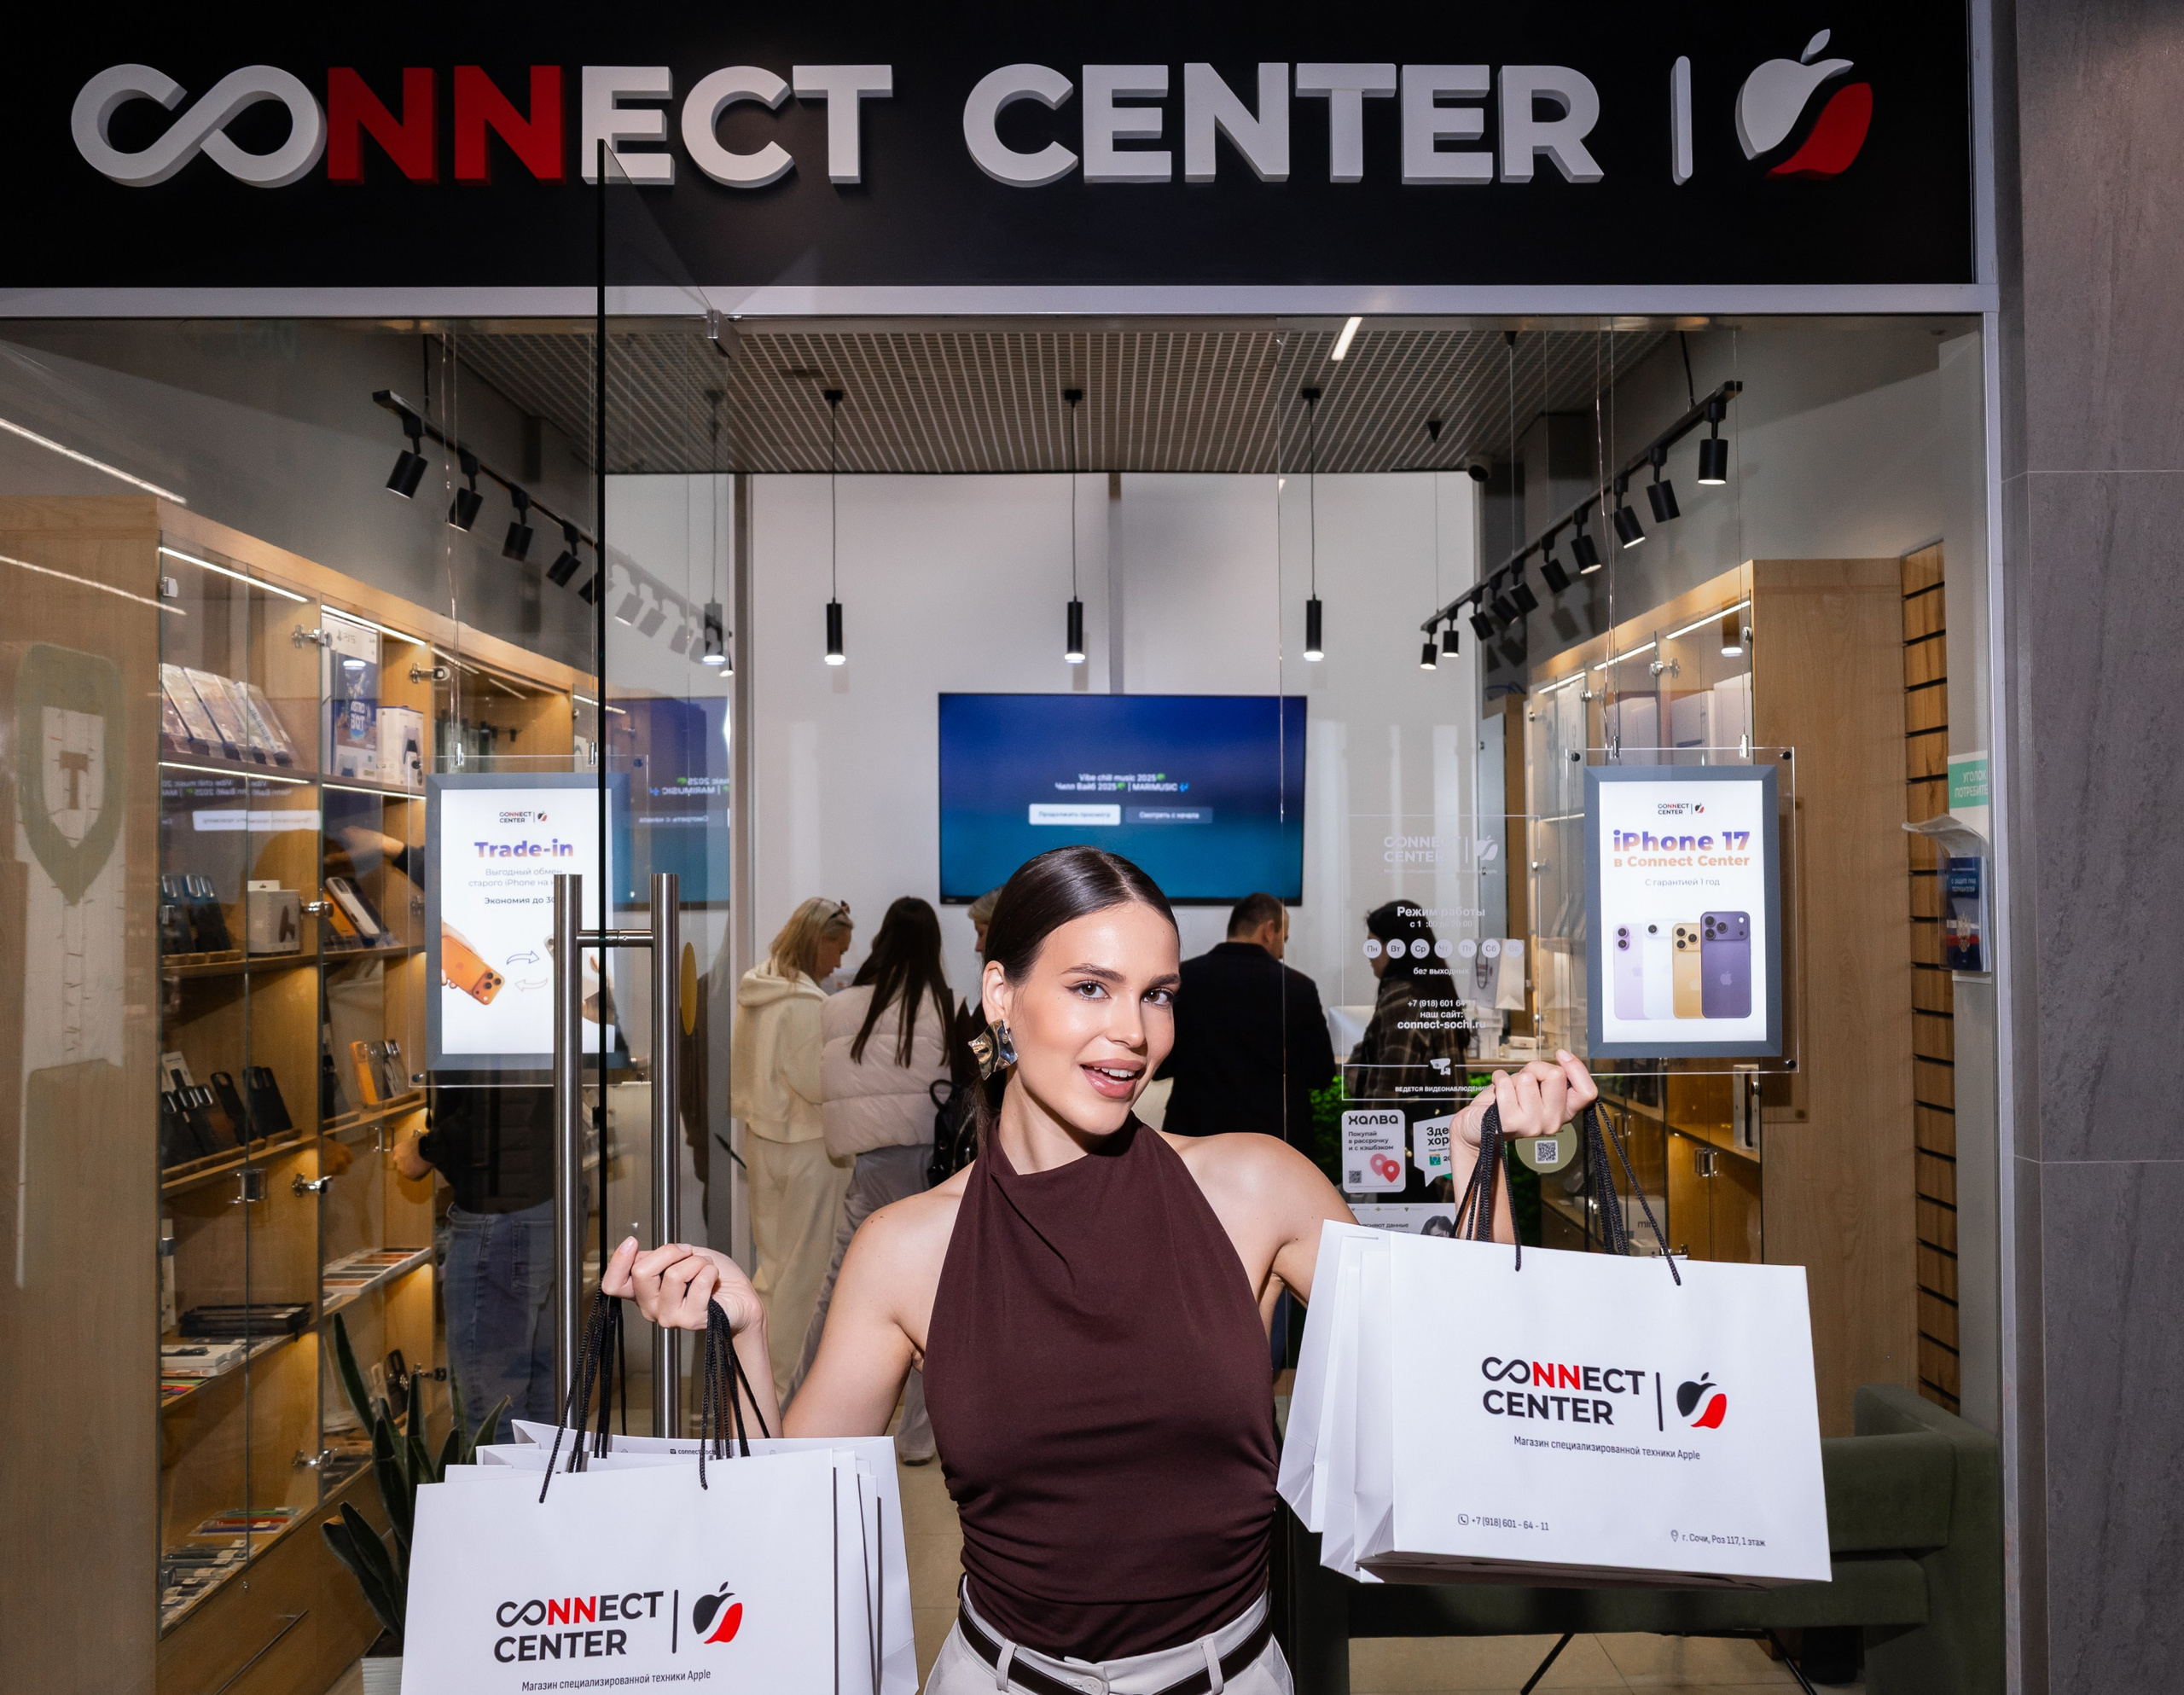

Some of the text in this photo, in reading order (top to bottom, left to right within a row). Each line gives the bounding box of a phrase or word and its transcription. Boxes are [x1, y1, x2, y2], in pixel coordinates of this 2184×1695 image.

[71, 62, 1605, 188] CONNECT CENTER
[1963, 770, 1987, 782] УГОЛОК
[1955, 786, 1989, 798] ПОТРЕБИТЕ
[1613, 829, 1751, 852] iPhone 17
[473, 839, 573, 857] Trade-in
[1613, 855, 1750, 868] в Connect Center
[485, 868, 531, 877] Выгодный
[1653, 879, 1699, 887] гарантией
[1705, 879, 1721, 887] год
[532, 897, 544, 905] до
[1397, 906, 1485, 918] Режим работы
[1414, 945, 1426, 954] Ср
[1419, 1000, 1438, 1008] (918)
[1440, 1010, 1464, 1019] сайт:
[1397, 1019, 1486, 1030] connect-sochi.ru
[1426, 1126, 1449, 1137] Зде
[1481, 1356, 1646, 1396] CONNECT
[1482, 1389, 1615, 1425] CENTER
[1513, 1436, 1701, 1461] Магазин специализированной техники Apple
[1472, 1517, 1481, 1525] +7
[1482, 1517, 1502, 1529] (918)
[1502, 1518, 1517, 1529] 601
[1523, 1520, 1534, 1530] 64
[1541, 1522, 1550, 1531] 11
[1689, 1533, 1711, 1545] Сочи,
[1711, 1535, 1726, 1544] Роз
[1727, 1536, 1741, 1547] 117,
[1742, 1537, 1746, 1546] 1
[1747, 1539, 1767, 1547] этаж
[495, 1590, 665, 1628] CONNECT
[494, 1628, 628, 1663] CENTER
[521, 1669, 712, 1692] Магазин специализированной техники Apple
